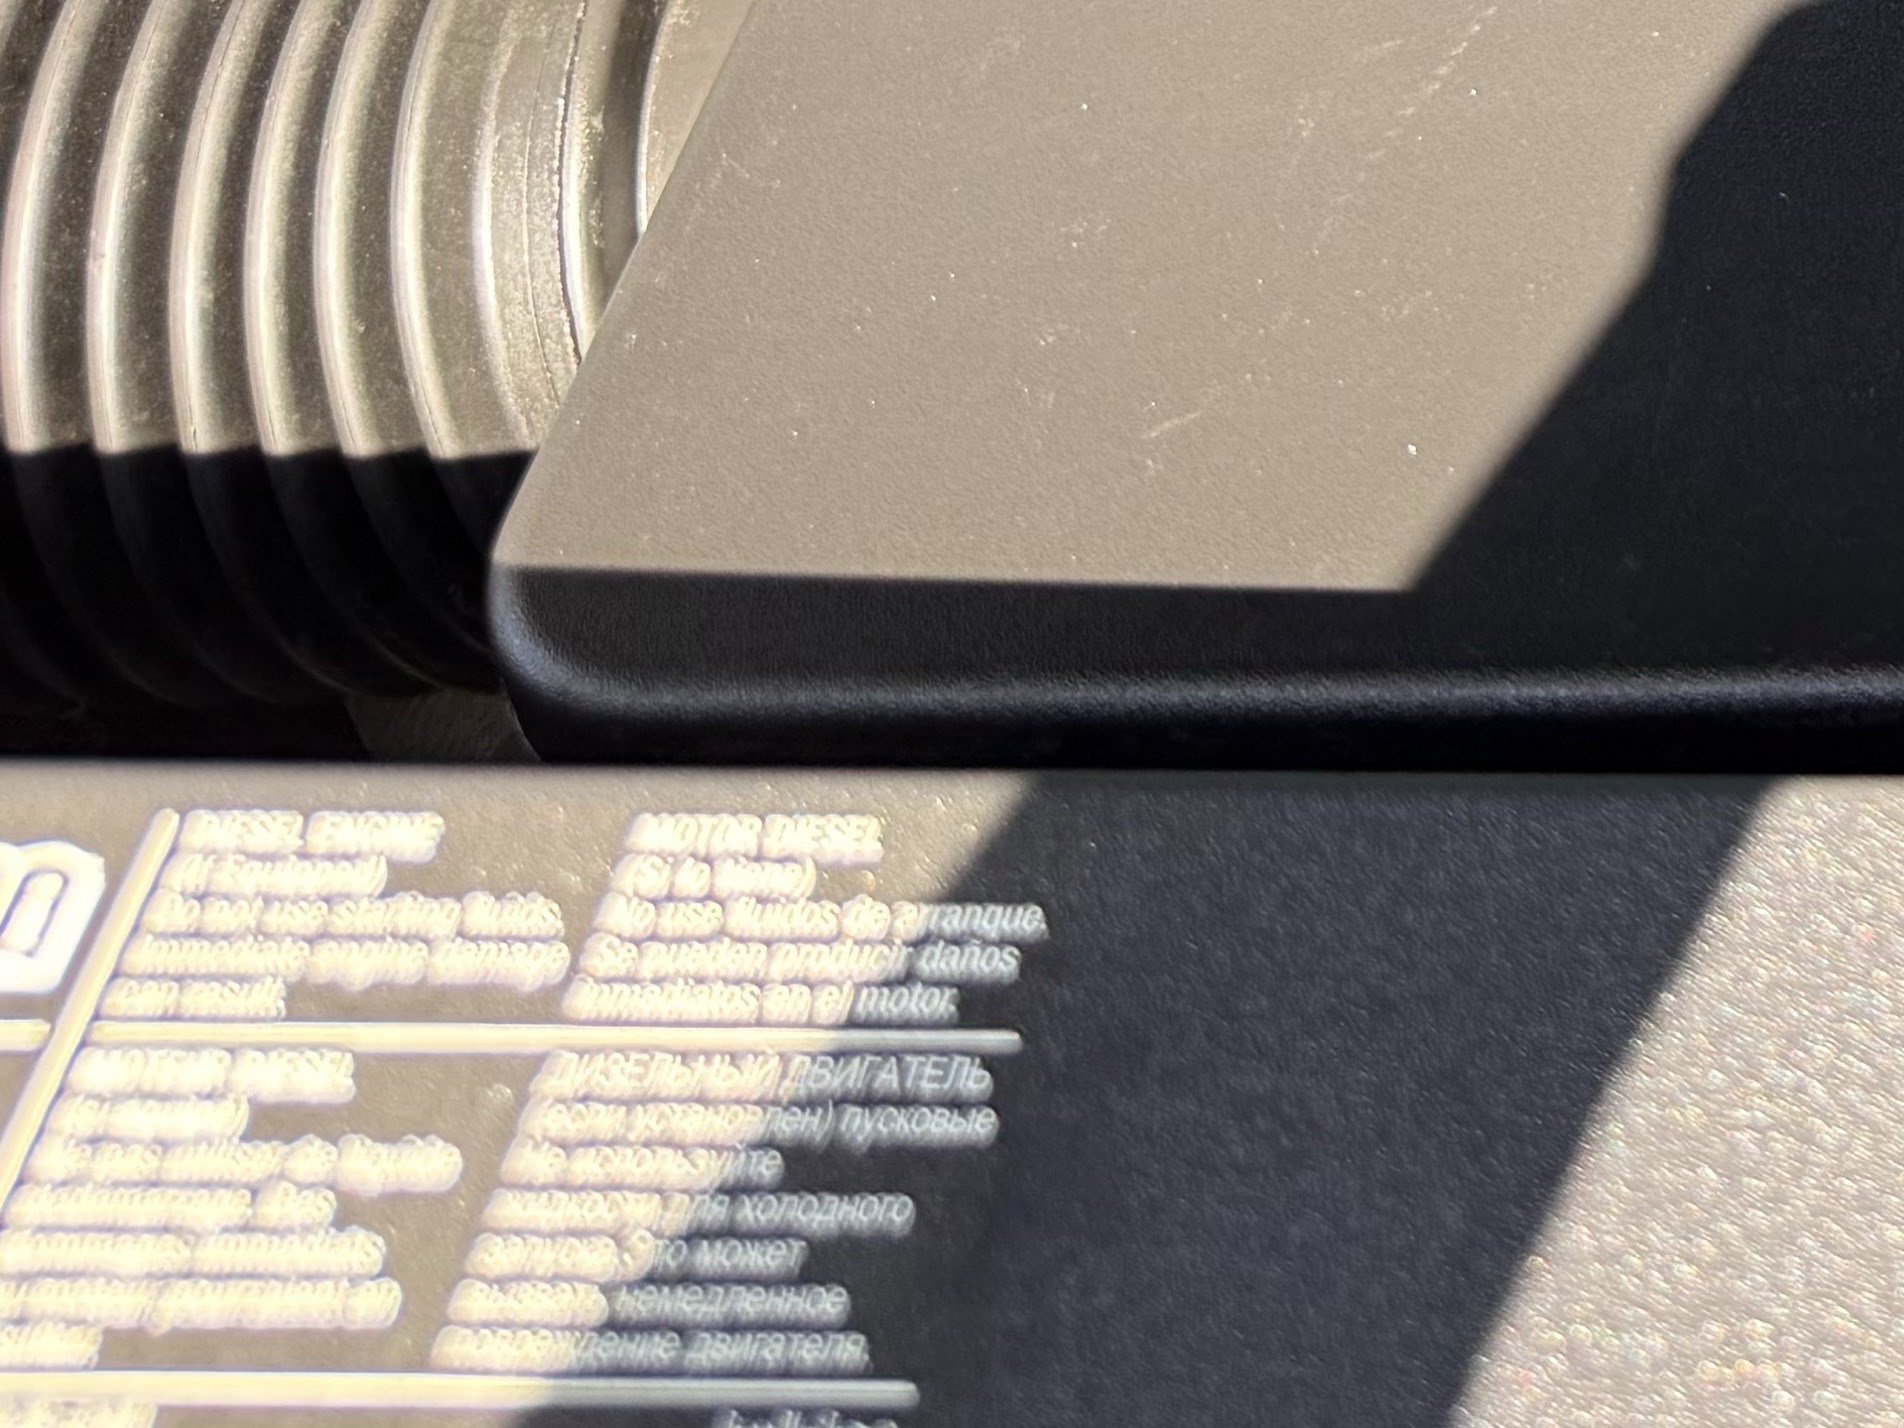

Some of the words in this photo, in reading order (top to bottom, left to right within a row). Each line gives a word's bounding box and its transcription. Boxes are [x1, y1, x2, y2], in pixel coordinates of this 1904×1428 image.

[626, 813, 762, 857] MOTOR
[763, 814, 884, 865] DIESEL
[656, 900, 724, 935] use
[889, 901, 1049, 942] arranque.
[769, 940, 911, 982] producir
[910, 940, 1021, 983] daños
[853, 983, 959, 1023] motor.
[780, 1051, 994, 1104] ДВИГАТЕЛЬ
[836, 1104, 1000, 1154] пусковые
[734, 1193, 916, 1237] холодного
[691, 1235, 808, 1282] может
[612, 1285, 850, 1327] немедленное
